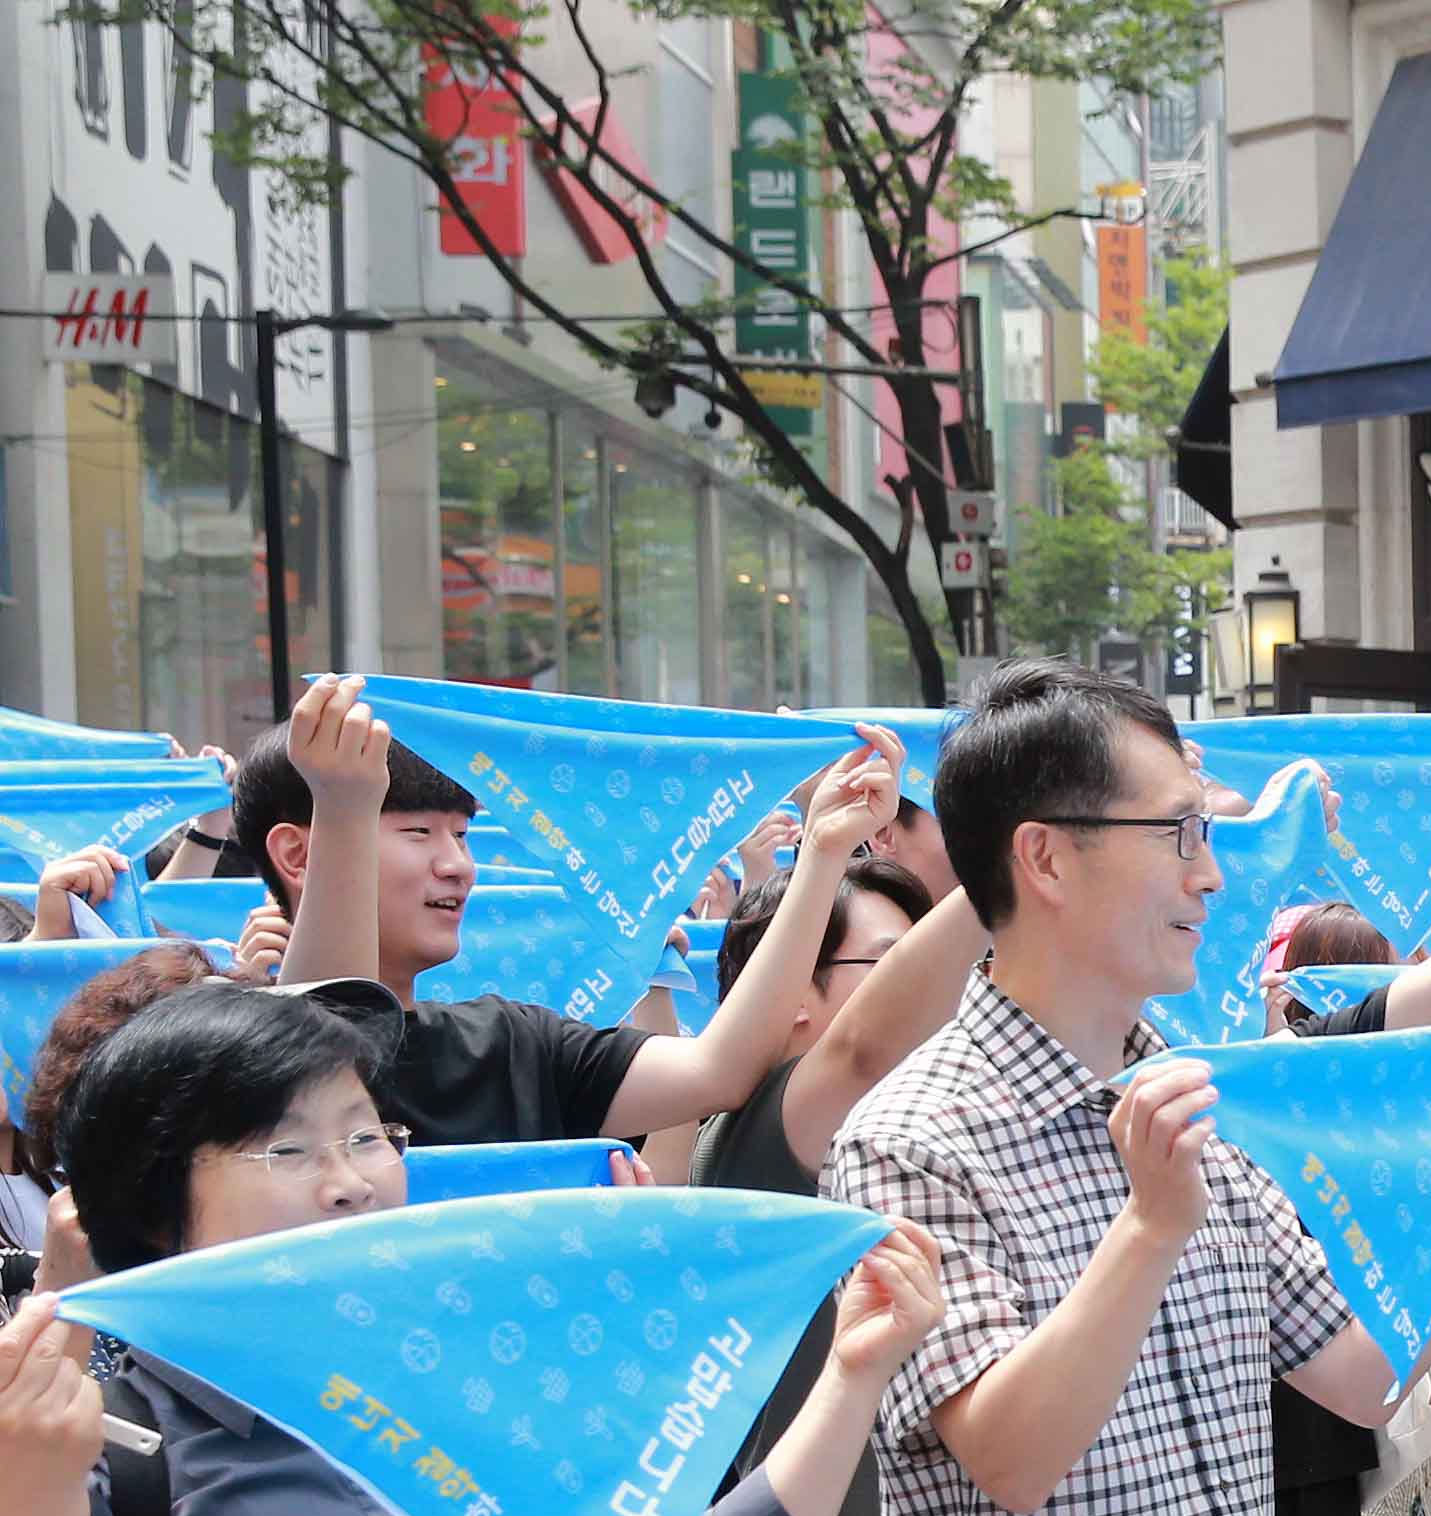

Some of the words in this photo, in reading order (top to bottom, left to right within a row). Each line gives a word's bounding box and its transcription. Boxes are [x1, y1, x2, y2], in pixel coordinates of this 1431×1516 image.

[56, 287, 150, 349] H&M
[469, 751, 528, 812] 에너지
[597, 890, 640, 938] 당신
[639, 769, 755, 919] 고맙습니다!
[1302, 1152, 1351, 1225] 에너지
[1393, 1307, 1421, 1361] 당신
[318, 1372, 422, 1455] 에너지
